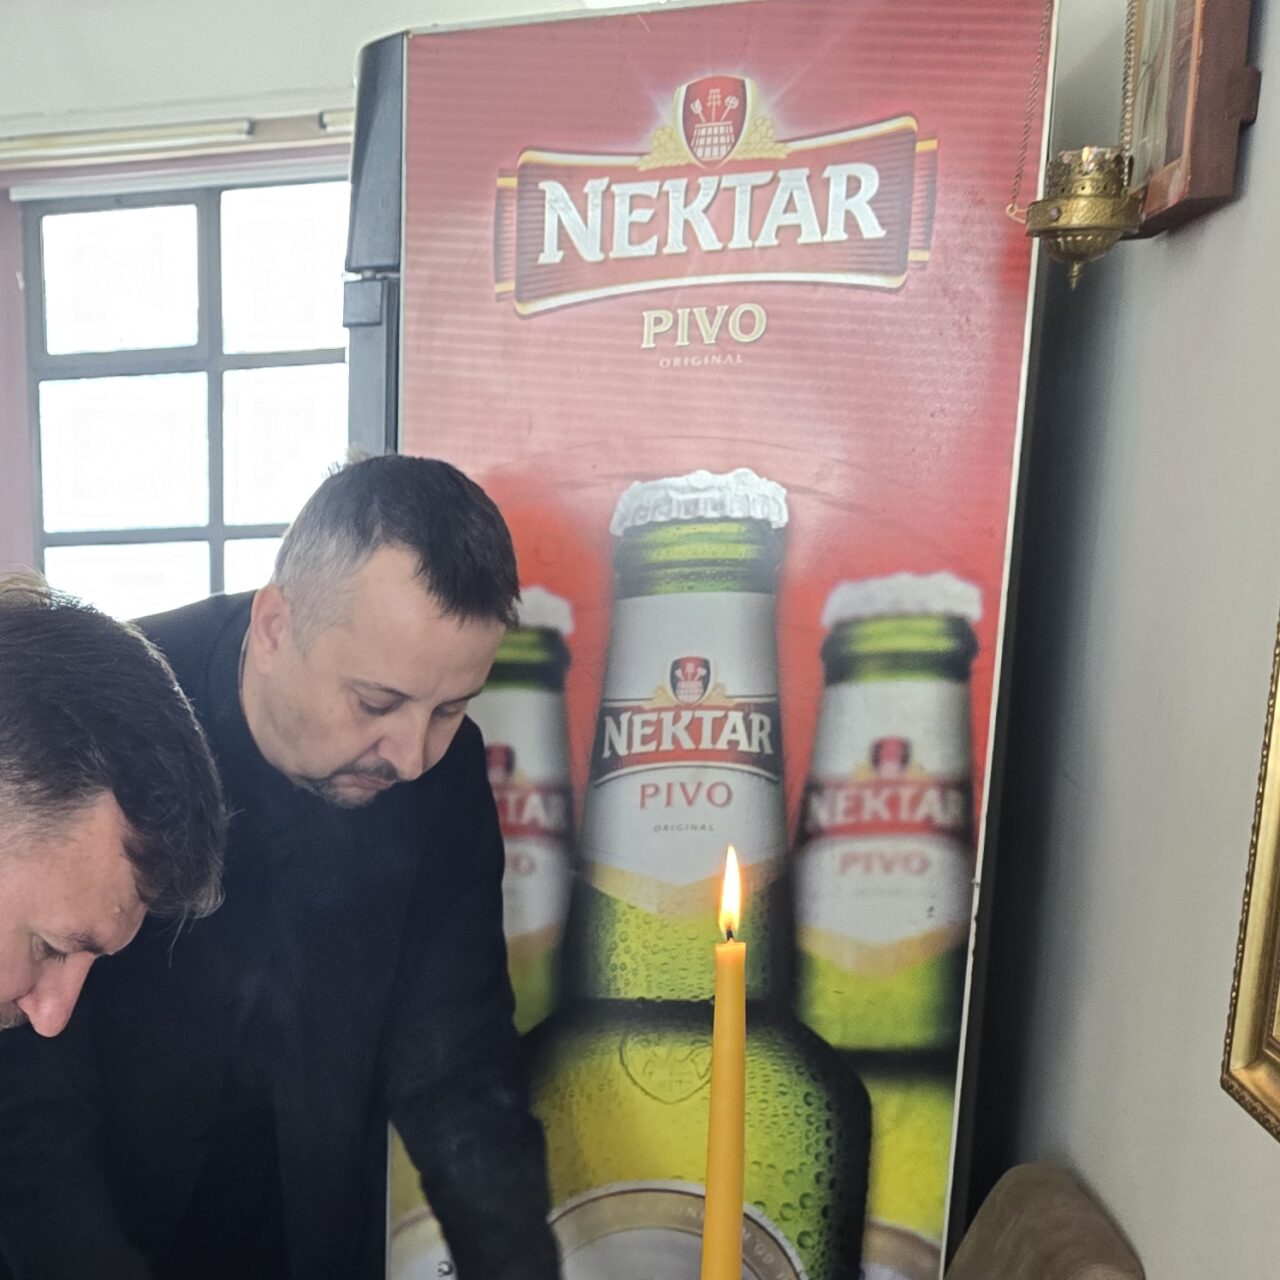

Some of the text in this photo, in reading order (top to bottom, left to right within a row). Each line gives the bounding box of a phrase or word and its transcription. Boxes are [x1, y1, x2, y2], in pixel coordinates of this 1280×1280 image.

[537, 163, 887, 264] NEKTAR
[640, 302, 767, 349] PIVO
[658, 353, 744, 369] ORIGINAL
[602, 707, 774, 758] NEKTAR
[639, 781, 734, 811] PIVO
[652, 823, 715, 833] ORIGINAL
[838, 851, 931, 876] PIVO
